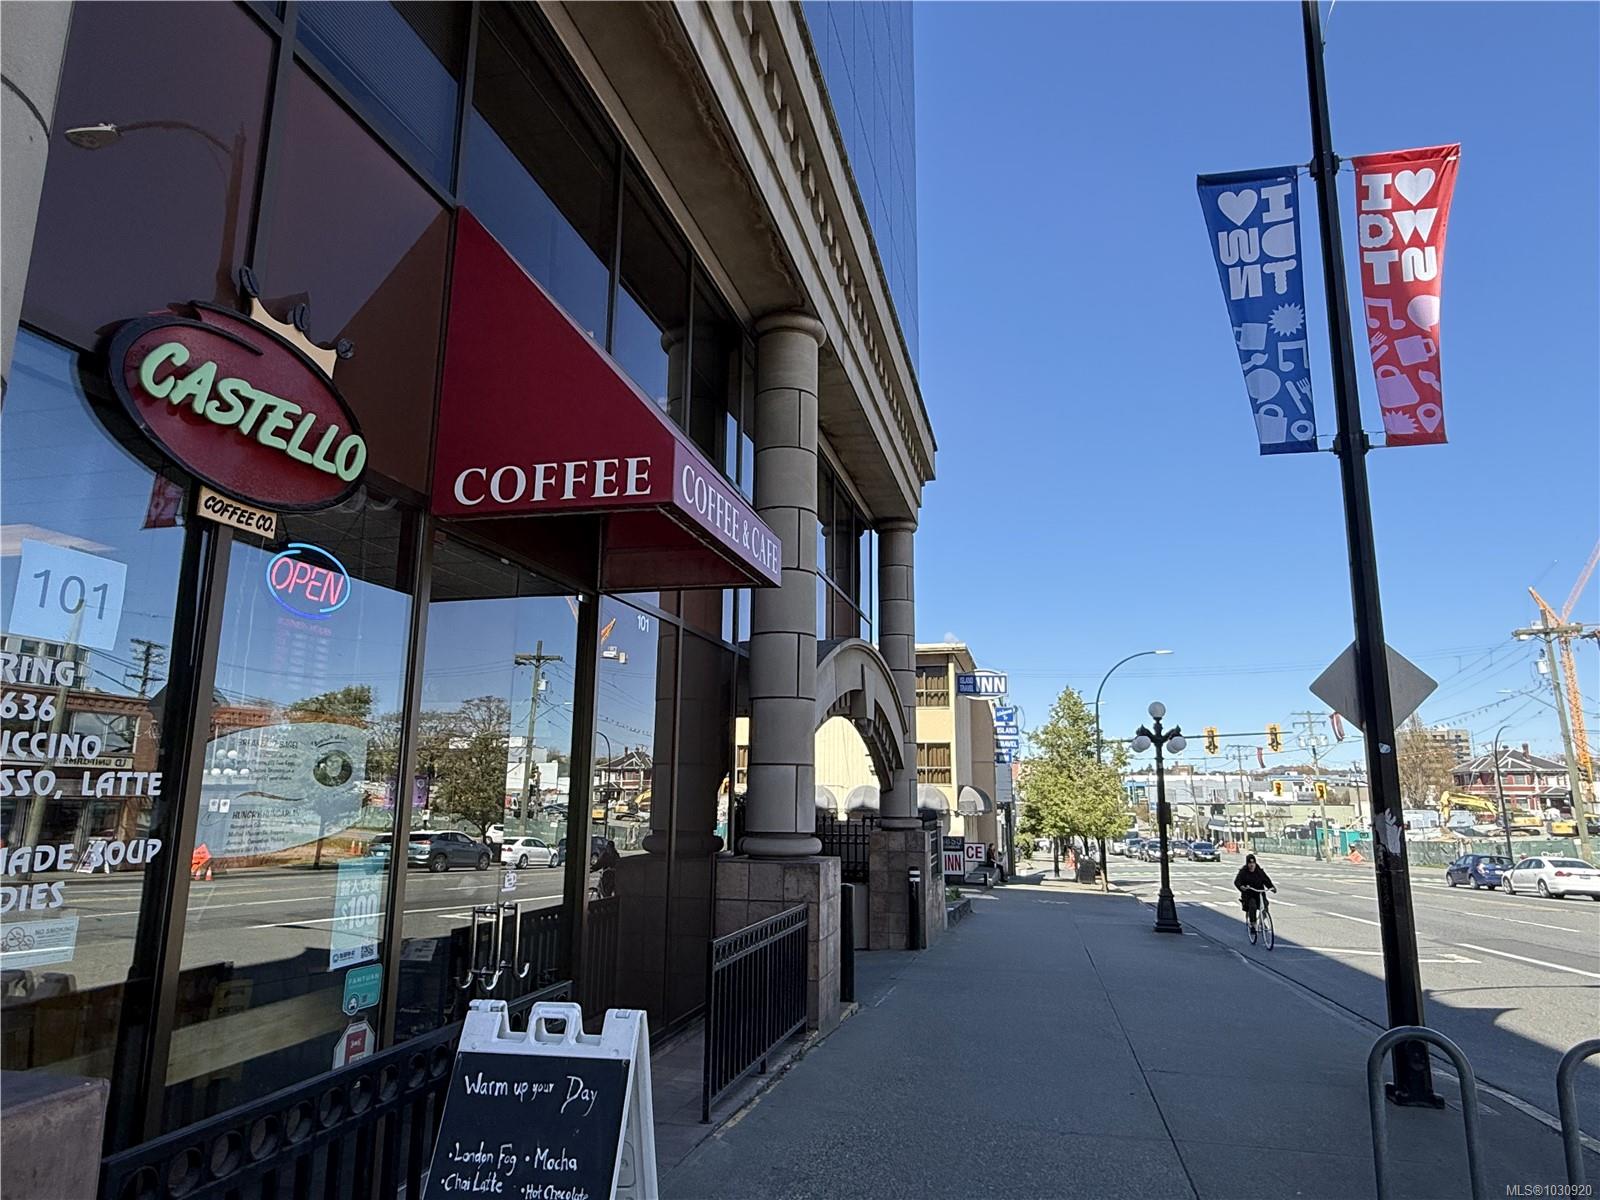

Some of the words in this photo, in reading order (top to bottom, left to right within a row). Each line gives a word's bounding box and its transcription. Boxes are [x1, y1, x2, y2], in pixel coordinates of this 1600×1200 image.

[140, 342, 367, 482] CASTELLO
[454, 457, 652, 506] COFFEE
[204, 496, 256, 526] COFFEE
[256, 514, 274, 532] CO.
[682, 464, 739, 544] COFFEE
[742, 519, 750, 550] &
[752, 525, 778, 575] CAFE
[33, 569, 109, 620] 101
[271, 557, 344, 605] OPEN
[637, 615, 650, 633] 101
[0, 652, 75, 687] RING
[976, 676, 1005, 693] INN
[0, 691, 56, 721] 636
[81, 771, 162, 799] LATTE
[92, 839, 162, 868] SOUP
[944, 854, 962, 871] INN
[0, 881, 65, 914] DIES
[464, 1072, 508, 1096] Warm
[513, 1081, 528, 1103] up
[532, 1083, 554, 1101] your
[560, 1075, 598, 1117] Day
[454, 1141, 493, 1170] London
[497, 1143, 517, 1176] Fog
[534, 1147, 577, 1171] Mocha
[444, 1173, 471, 1192] Chai
[472, 1171, 503, 1193] Latte
[525, 1184, 543, 1200] Hot
